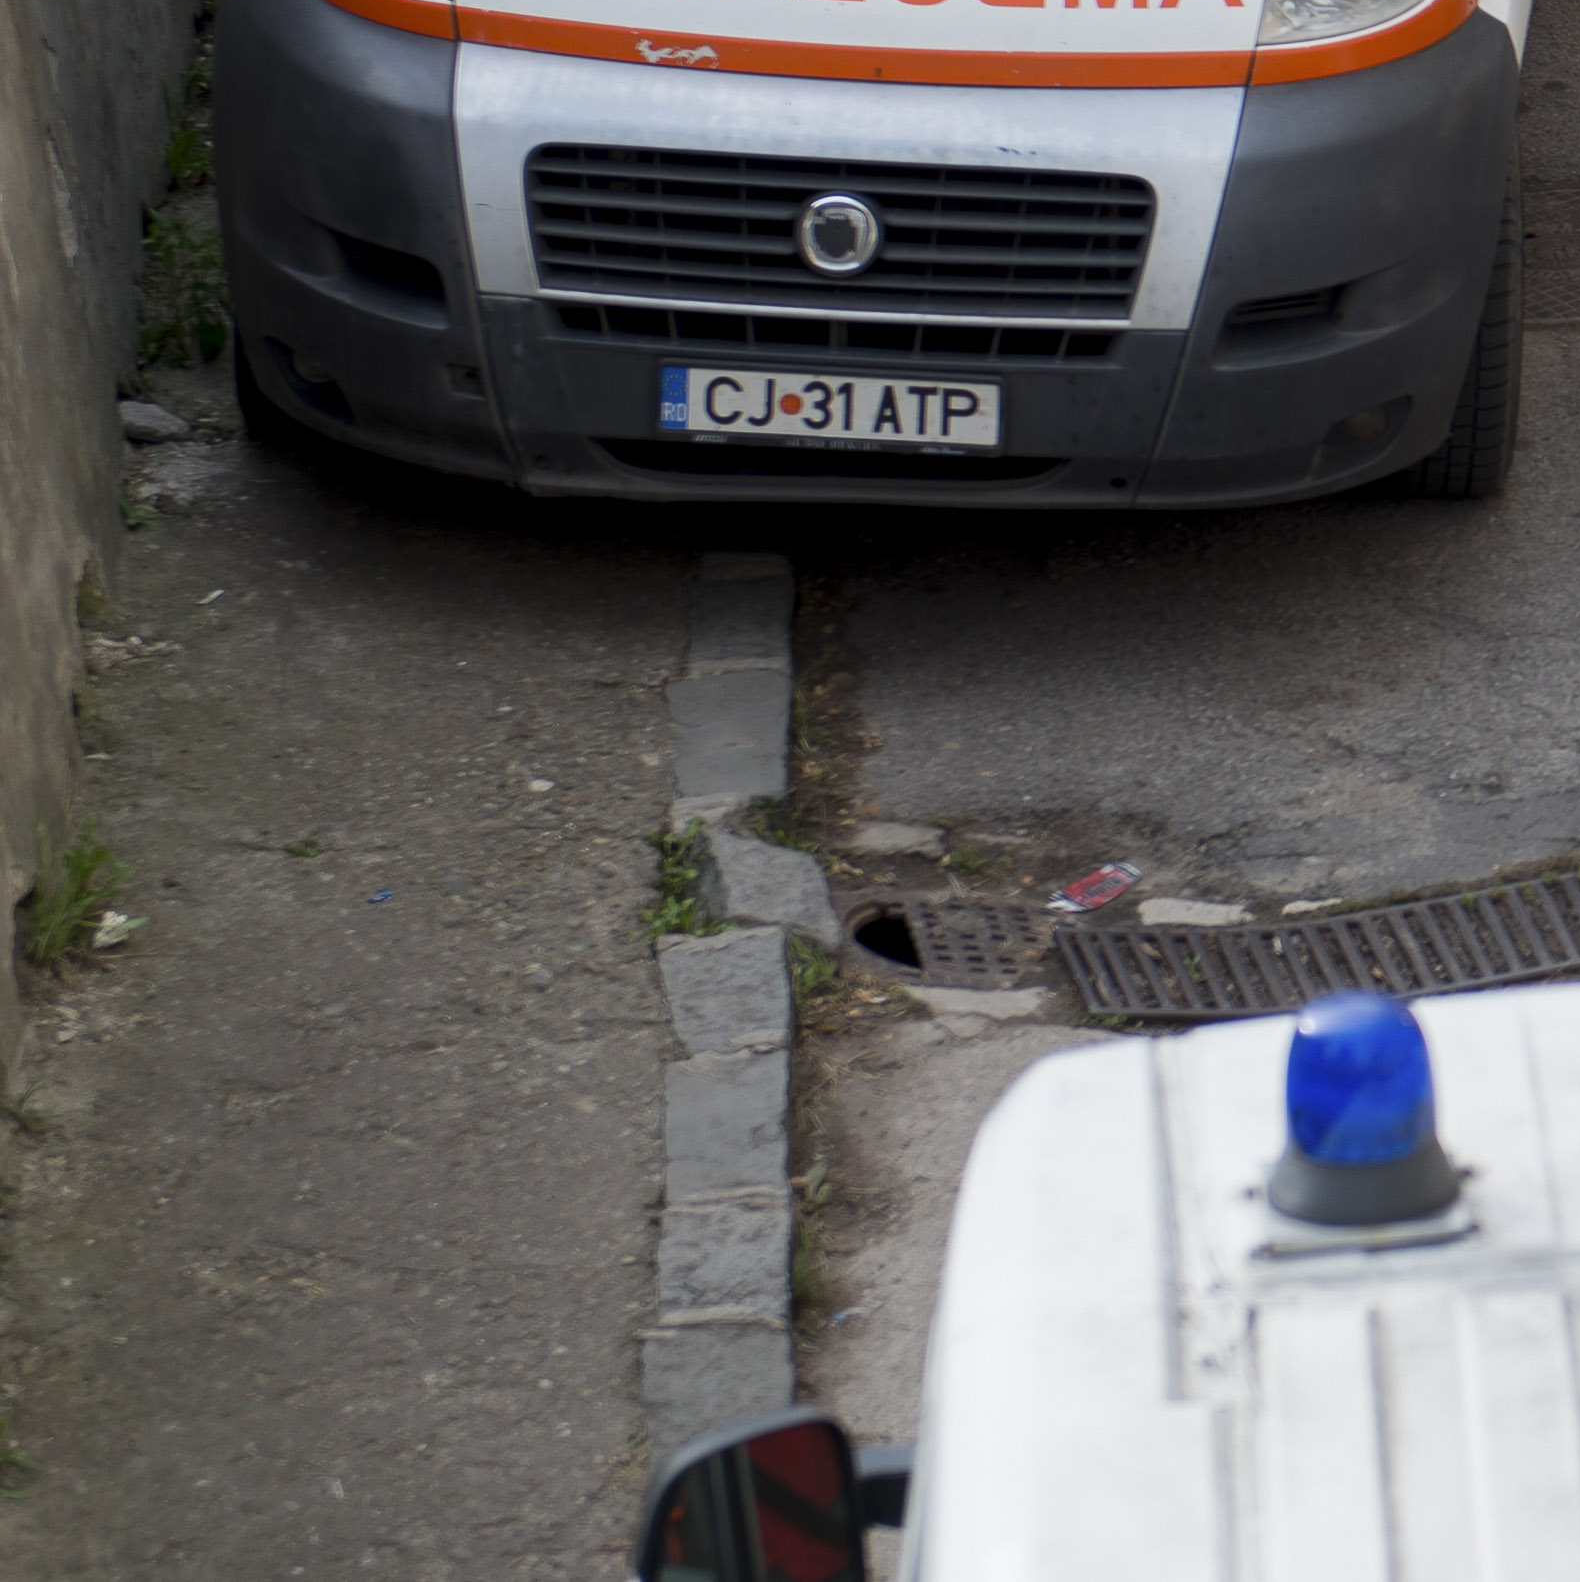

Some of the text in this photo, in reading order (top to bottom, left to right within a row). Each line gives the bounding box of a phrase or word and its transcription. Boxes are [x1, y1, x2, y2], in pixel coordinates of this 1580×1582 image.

[705, 375, 982, 437] CJ 31 ATP
